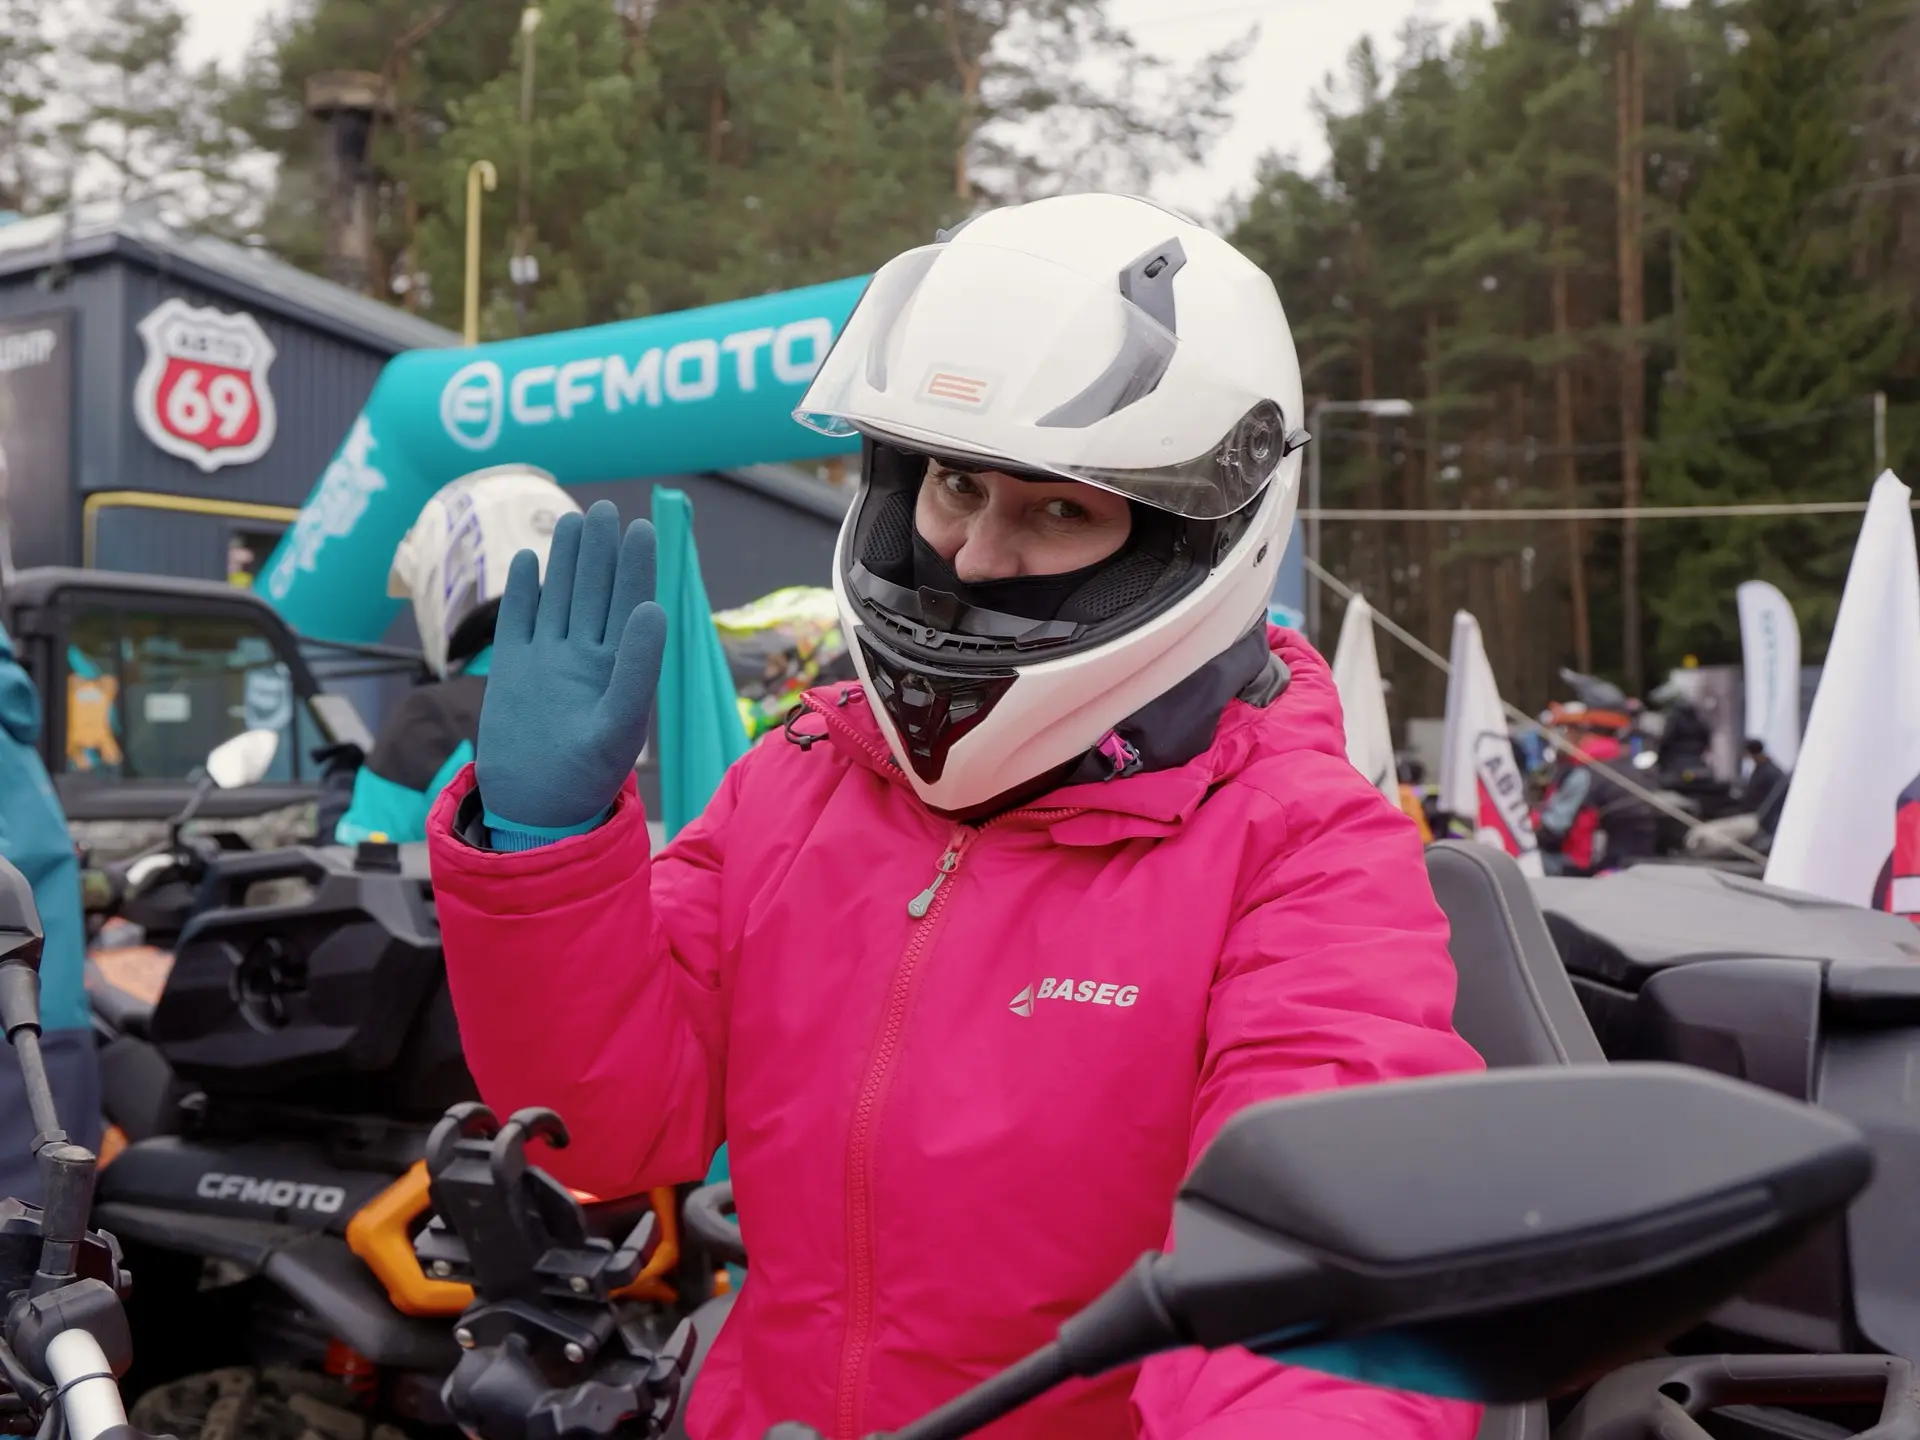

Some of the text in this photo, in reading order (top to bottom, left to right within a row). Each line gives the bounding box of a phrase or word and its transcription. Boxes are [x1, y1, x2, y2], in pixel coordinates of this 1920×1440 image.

[509, 317, 832, 425] CFMOTO
[166, 369, 251, 439] 69
[1036, 977, 1139, 1008] BASEG
[196, 1172, 346, 1214] CFMOTO
